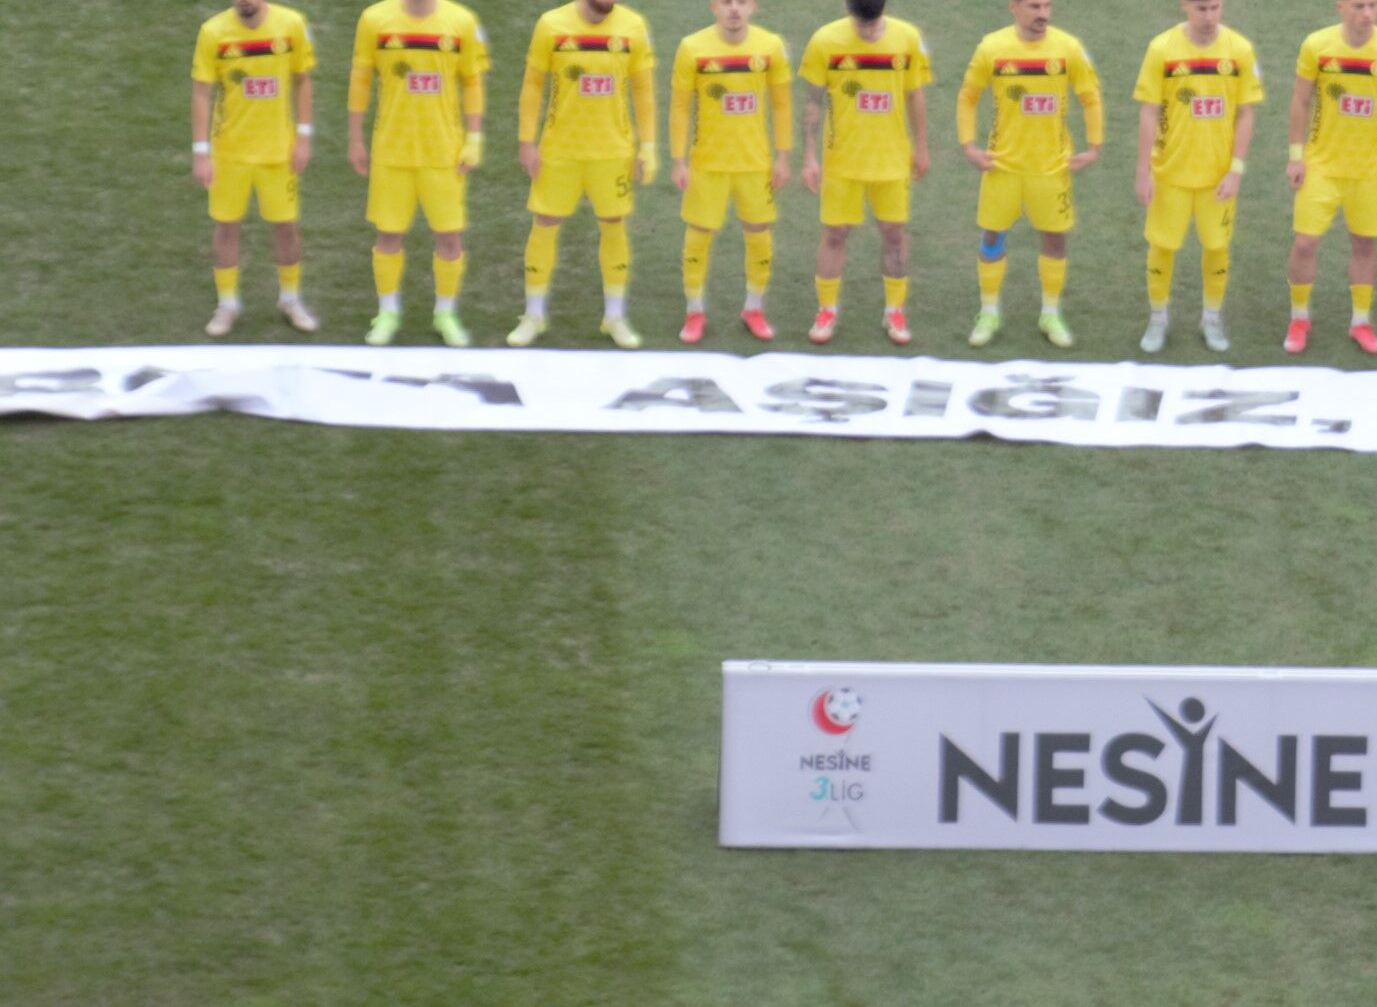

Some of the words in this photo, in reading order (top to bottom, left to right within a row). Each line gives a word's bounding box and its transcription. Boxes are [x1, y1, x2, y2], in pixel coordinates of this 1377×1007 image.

[599, 373, 1353, 433] AŞIĞIZ,
[799, 750, 872, 772] NESİNE
[939, 696, 1369, 827] NESİNE
